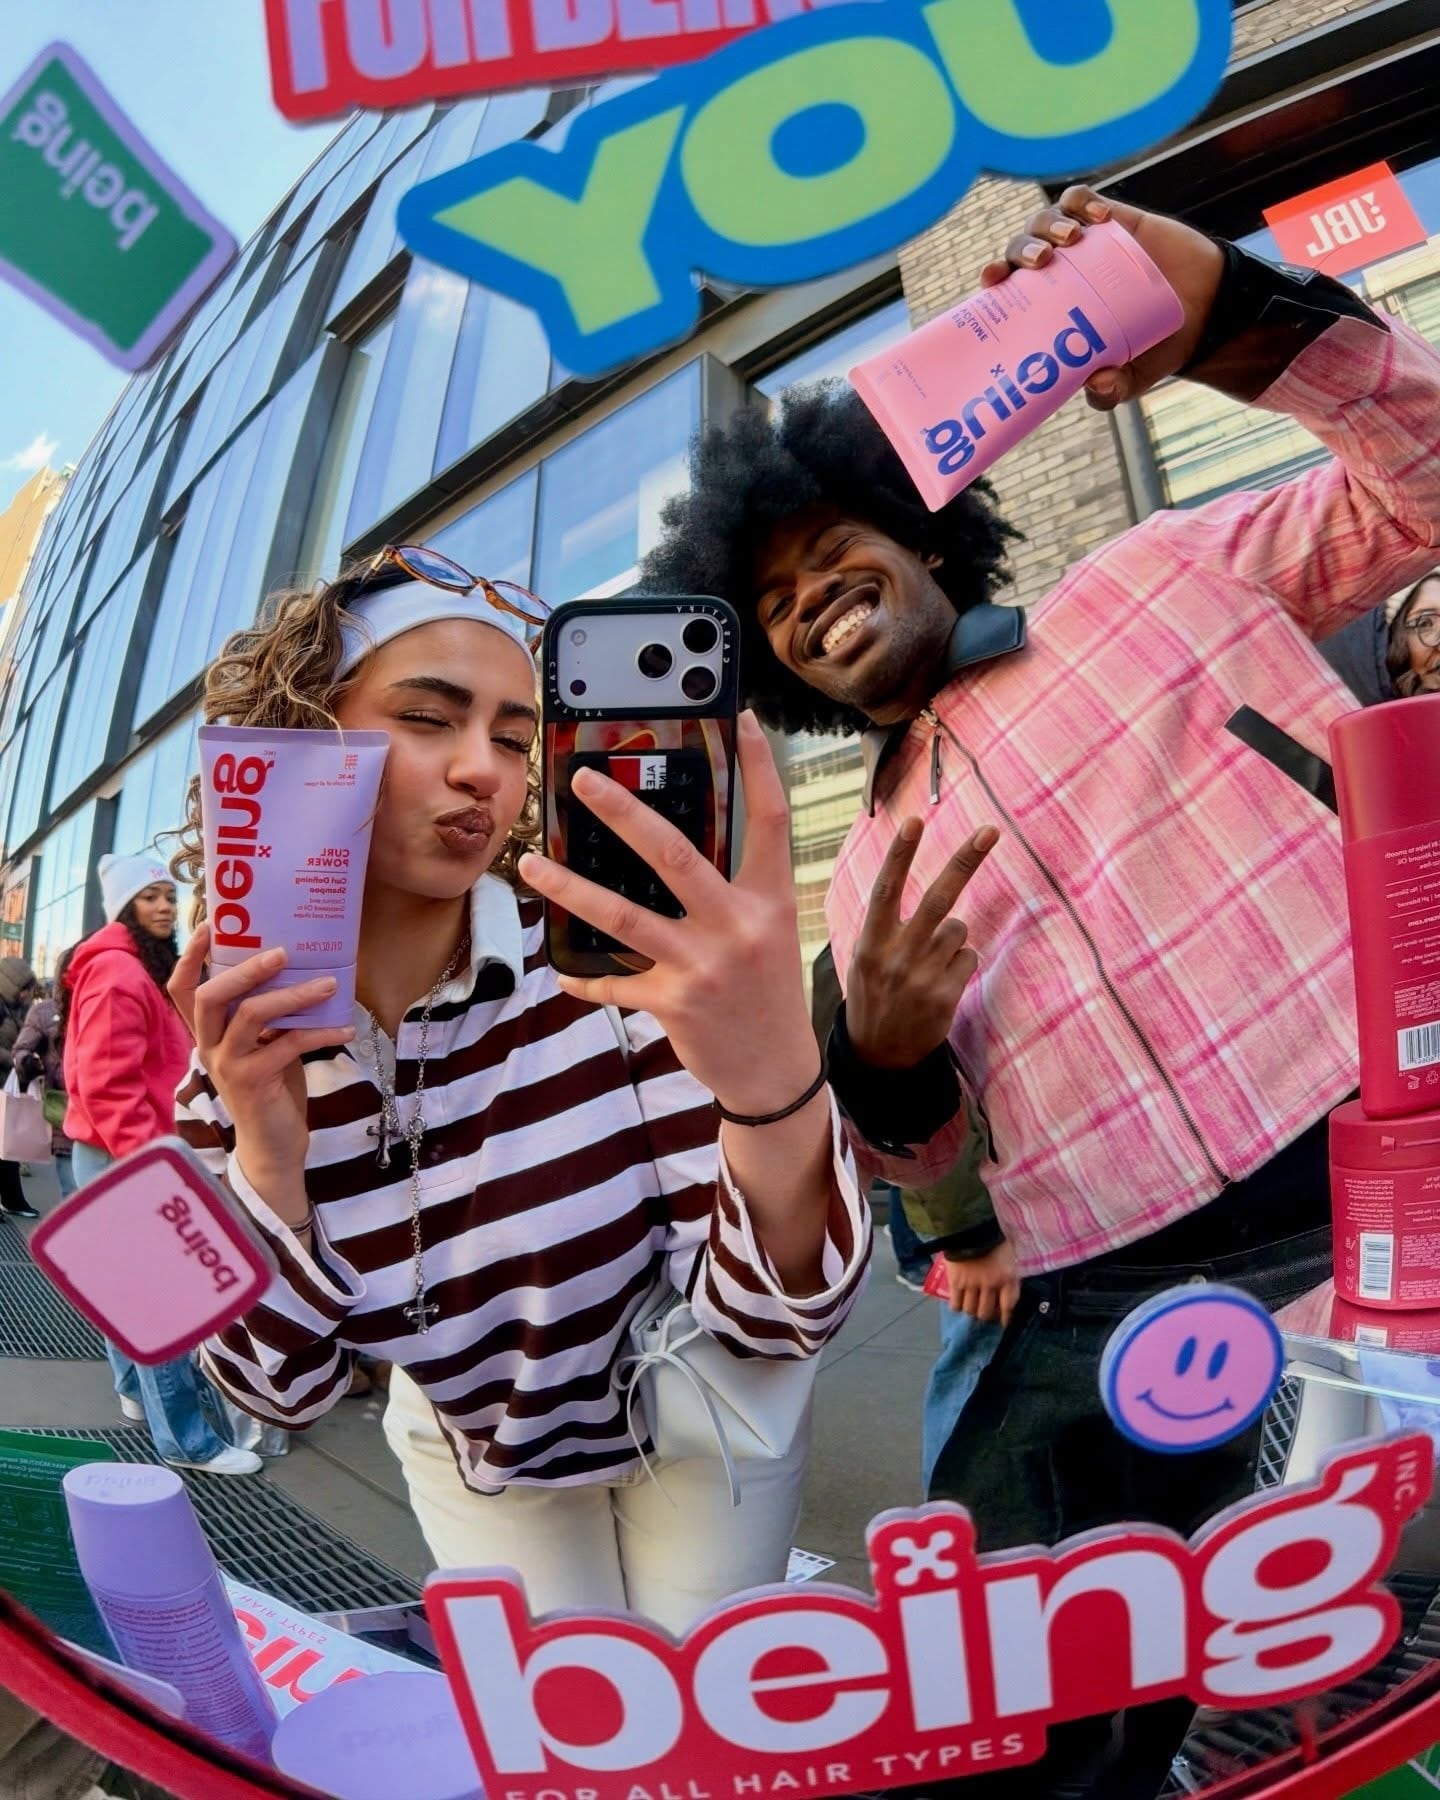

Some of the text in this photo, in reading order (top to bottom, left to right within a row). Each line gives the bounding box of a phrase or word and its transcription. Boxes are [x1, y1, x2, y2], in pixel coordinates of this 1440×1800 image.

[11, 90, 159, 251] being
[431, 0, 1200, 336] YOU
[156, 1196, 239, 1292] being
[1394, 1450, 1418, 1511] INC.
[445, 1462, 1384, 1774] being
[733, 1763, 852, 1795] HAIR
[873, 1733, 1025, 1777] TYPES
